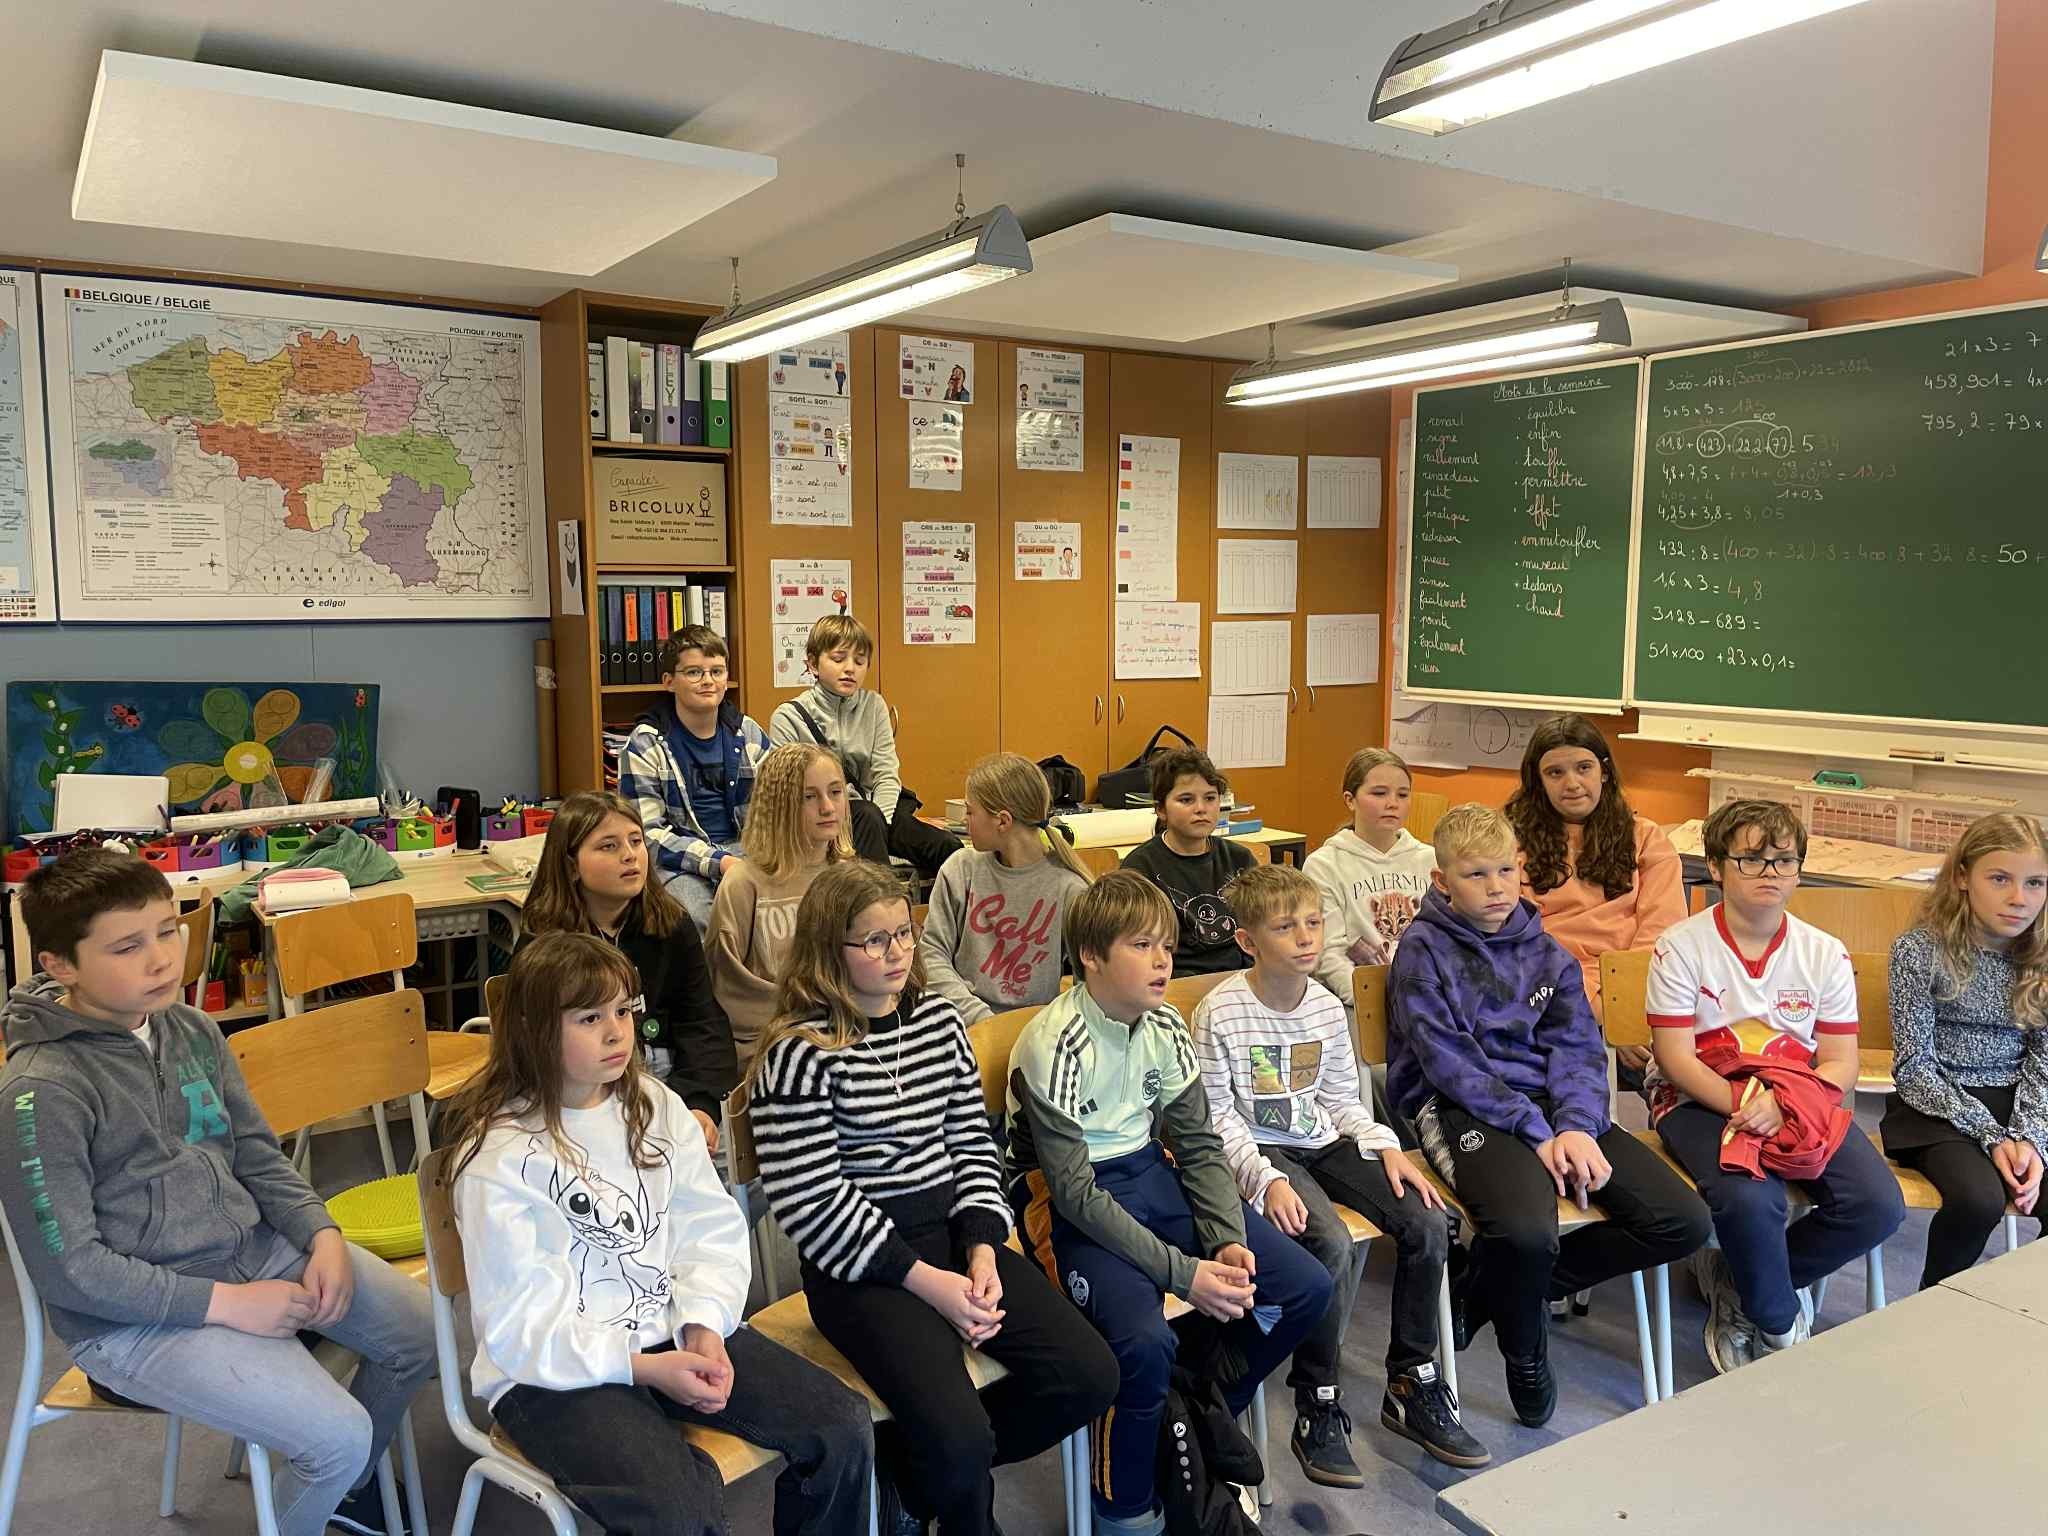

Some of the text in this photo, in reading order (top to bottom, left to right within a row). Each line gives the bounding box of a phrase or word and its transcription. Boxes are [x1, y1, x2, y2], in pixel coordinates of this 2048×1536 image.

[82, 289, 152, 305] BELGIQUE
[450, 327, 485, 336] POLITIQUE
[1494, 376, 1603, 398] Mots de la semaine
[1528, 422, 1561, 451] enfin
[1523, 446, 1567, 479] touffu
[1522, 470, 1588, 499] permettre
[609, 500, 695, 515] BRICOLUX
[1423, 507, 1470, 528] pratique
[1526, 494, 1561, 530] effet
[1658, 540, 1686, 557] 432
[1997, 543, 2027, 563] 50
[1522, 560, 1568, 570] museau
[1523, 574, 1562, 594] dedans
[1419, 589, 1467, 609] facilement
[1526, 593, 1565, 618] chaud
[1652, 606, 1746, 630] 3128 689
[1353, 872, 1428, 900] PALERMO
